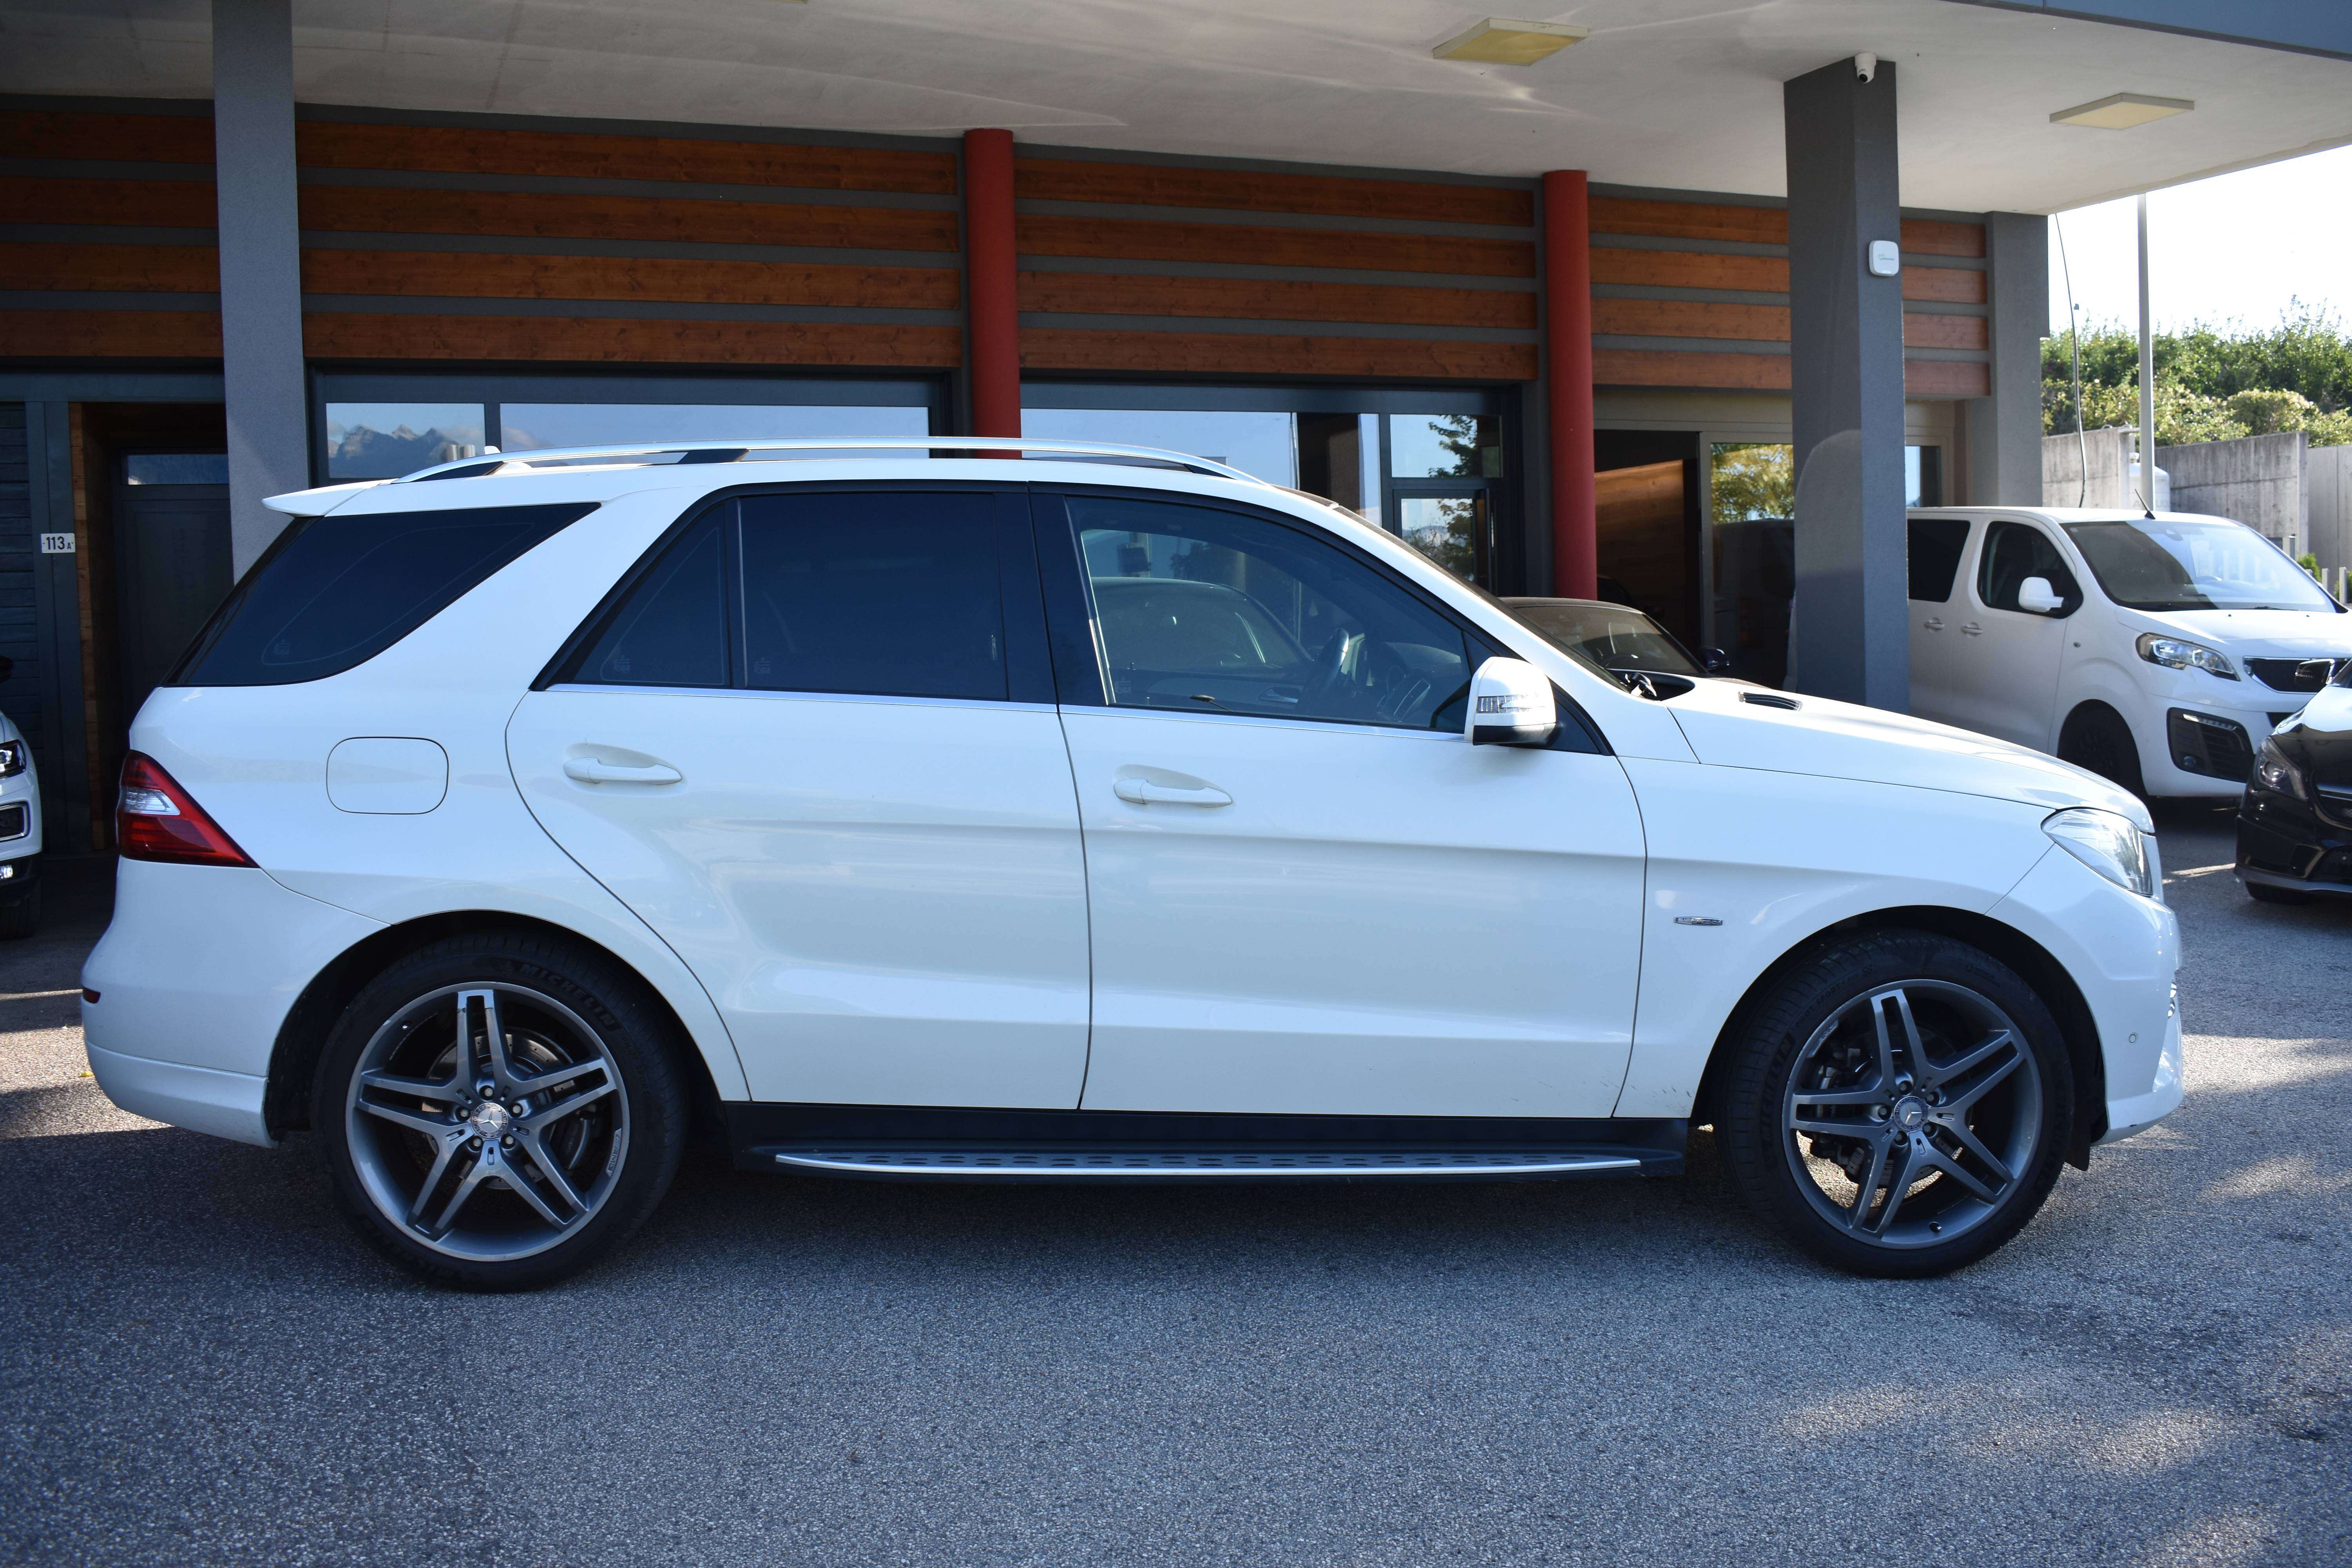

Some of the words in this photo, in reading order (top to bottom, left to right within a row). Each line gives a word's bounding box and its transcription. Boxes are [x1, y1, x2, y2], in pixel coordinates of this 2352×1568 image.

[519, 963, 616, 1025] MICHELIN
[1795, 1004, 1814, 1029] PILOT
[1816, 983, 1840, 1006] SPORT
[634, 1064, 650, 1094] SPORT
